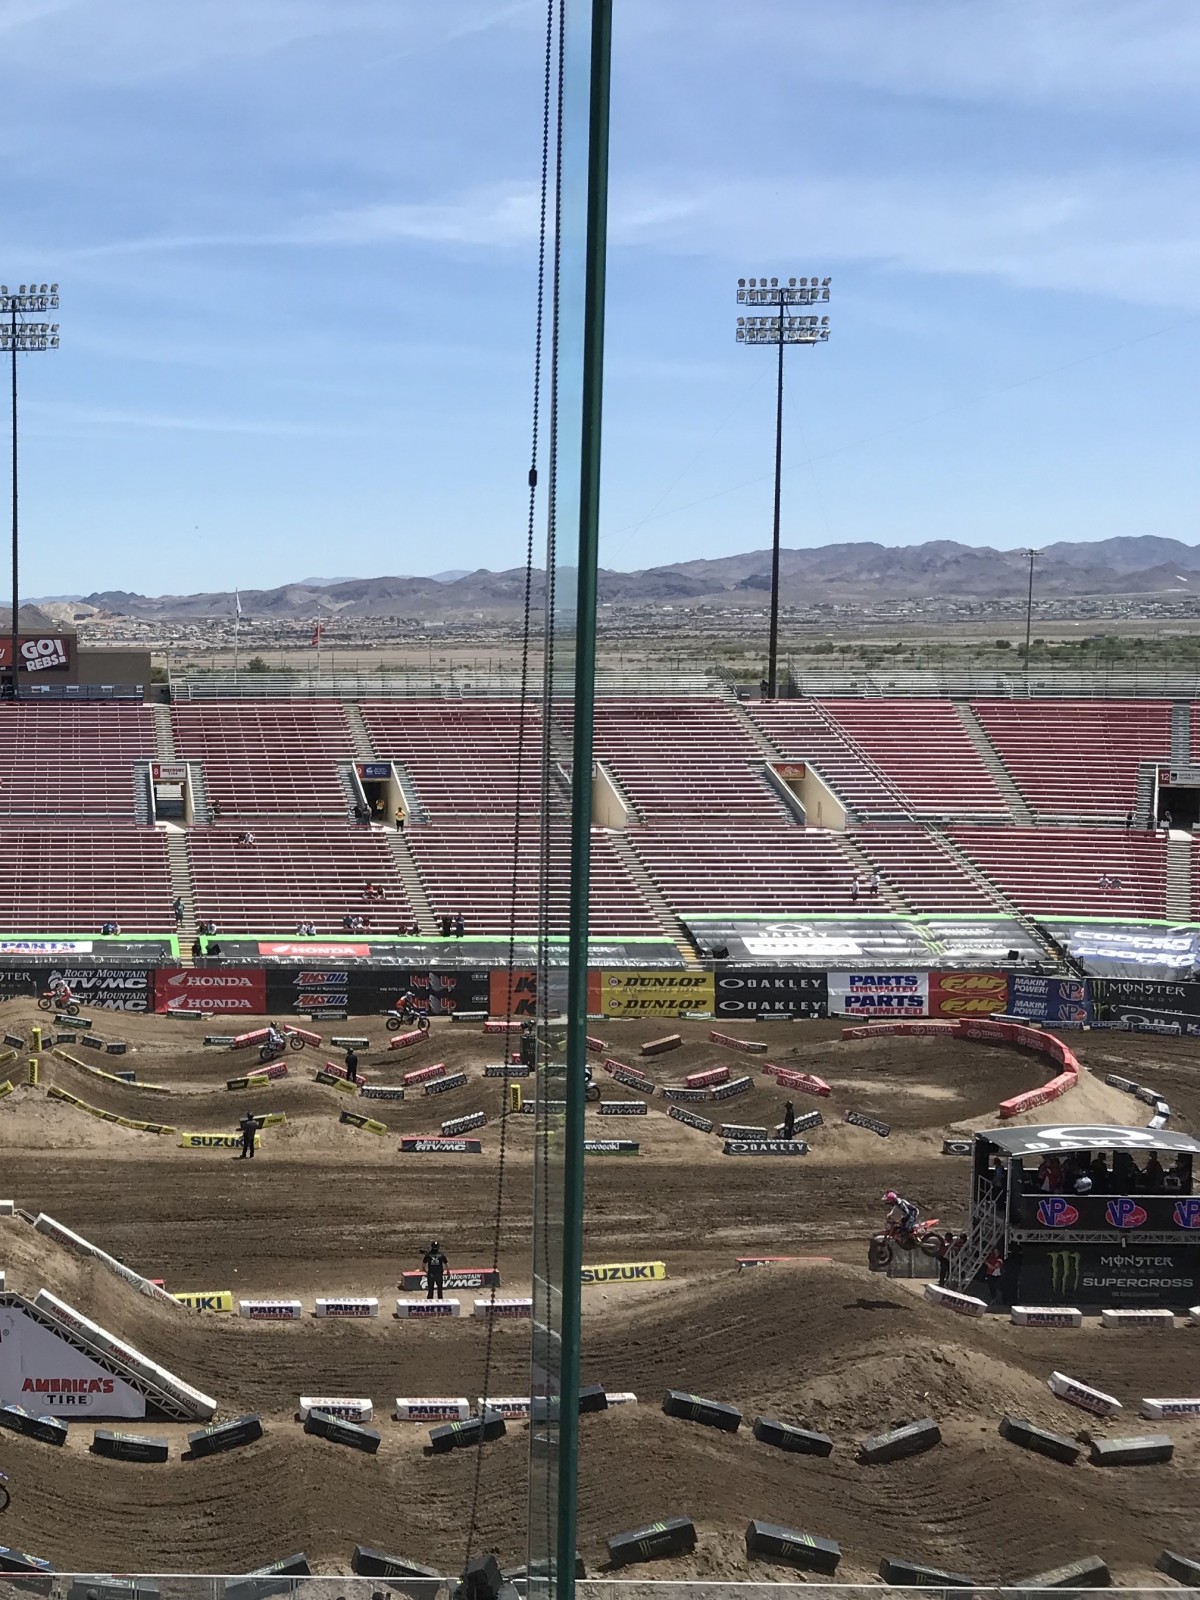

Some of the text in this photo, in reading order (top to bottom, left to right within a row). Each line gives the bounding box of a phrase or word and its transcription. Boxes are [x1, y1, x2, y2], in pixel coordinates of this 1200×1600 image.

[154, 768, 158, 776] 8
[286, 946, 358, 954] HONDA
[187, 977, 252, 986] HONDA
[293, 972, 348, 985] AMSOIL
[624, 977, 706, 987] DUNLOP
[747, 979, 821, 988] OAKLEY
[849, 975, 918, 986] PARTS
[941, 978, 1007, 989] FMF
[1015, 978, 1049, 986] MAKIN'
[1013, 985, 1049, 994] POWER!
[1060, 982, 1080, 1000] VP
[1110, 983, 1186, 997] MONSTER
[98, 991, 147, 999] MOUNTAIN
[187, 999, 252, 1008] HONDA
[293, 994, 348, 1007] AMSOIL
[624, 1000, 706, 1009] DUNLOP
[747, 1001, 821, 1010] OAKLEY
[845, 996, 924, 1007] PARTS
[1015, 1000, 1048, 1009] MAKIN'
[941, 1001, 1007, 1012] FMF
[1013, 1006, 1048, 1016] POWER!
[1059, 1005, 1081, 1021] VP
[981, 1030, 1004, 1039] TOYOTA
[420, 1067, 443, 1078] TOYOTA
[704, 1070, 728, 1082] TOYOTA
[191, 1137, 244, 1147] SUZUK
[1024, 1140, 1196, 1150] OAKLEY
[1038, 1198, 1066, 1226] VP
[1107, 1198, 1135, 1227] VP
[1101, 1255, 1174, 1267] MONSTER
[582, 1265, 655, 1282] SUZUKI
[1083, 1278, 1193, 1287] SUPERCROSS
[251, 1306, 293, 1315] PARTS
[325, 1303, 371, 1312] PARTS
[51, 1305, 82, 1329] AMERICA'S
[1027, 1313, 1073, 1321] PARTS
[1118, 1316, 1165, 1324] PARTS
[108, 1344, 140, 1368] AMERICA'S
[21, 1378, 114, 1393] AMERICA'S
[47, 1395, 87, 1404] TIRE
[164, 1385, 198, 1409] tires.com
[1067, 1385, 1113, 1411] PARTS
[408, 1405, 459, 1414] PARTS
[491, 1403, 531, 1412] PART
[1162, 1404, 1200, 1412] PART
